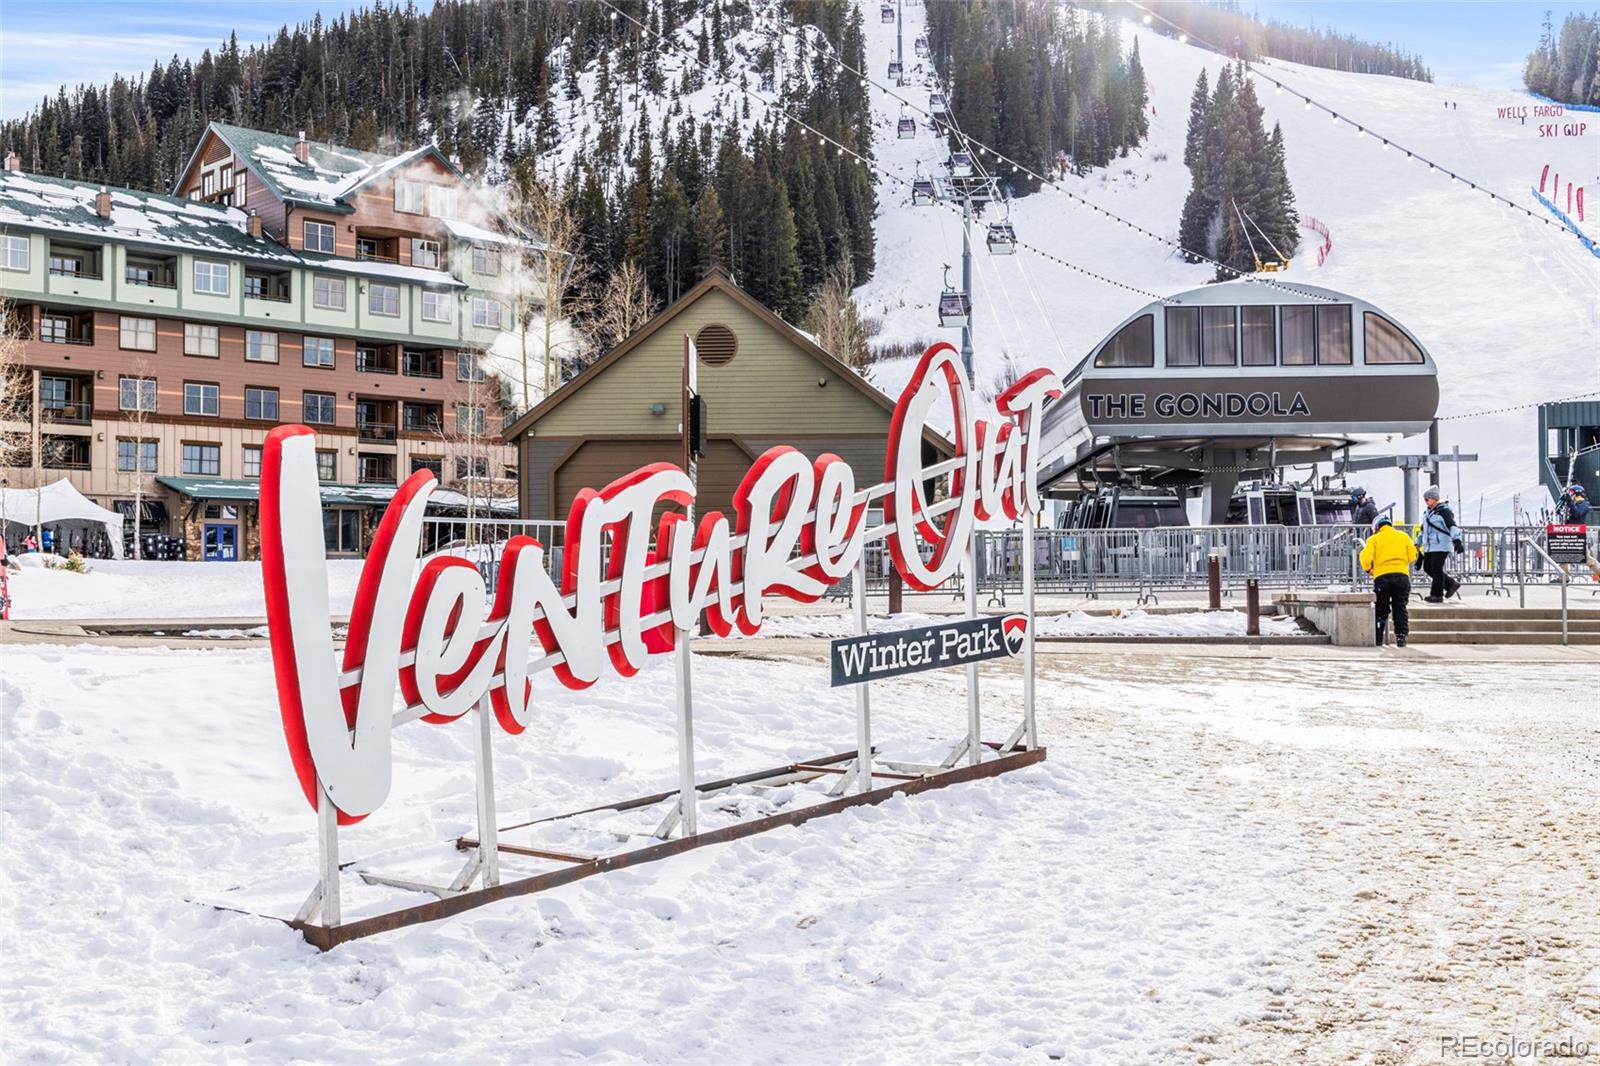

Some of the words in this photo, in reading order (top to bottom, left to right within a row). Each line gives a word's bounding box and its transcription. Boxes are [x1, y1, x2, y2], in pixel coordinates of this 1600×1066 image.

[1497, 106, 1528, 119] WELLS
[1533, 105, 1563, 117] FARGO
[1539, 124, 1558, 137] SKI
[1087, 393, 1147, 418] THE
[1153, 392, 1312, 418] GONDOLA
[837, 637, 935, 678] Winter
[939, 623, 1001, 661] Park
